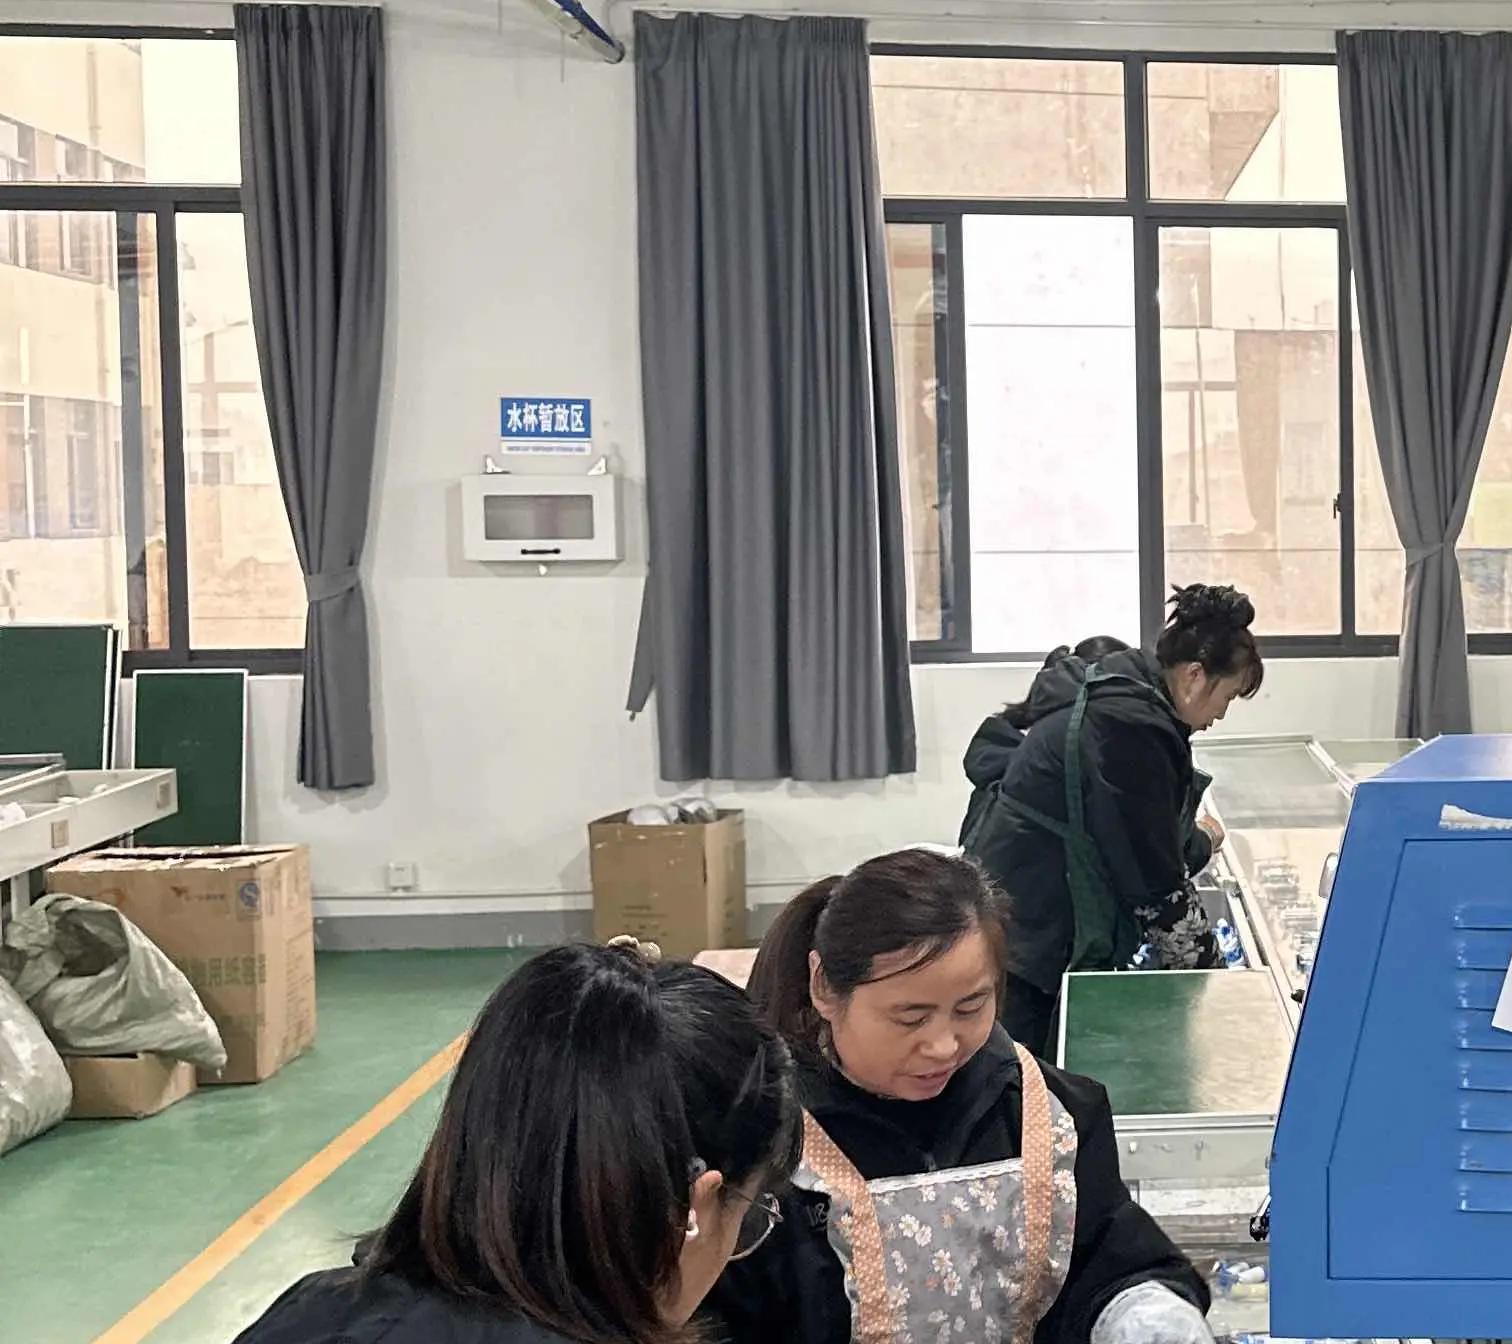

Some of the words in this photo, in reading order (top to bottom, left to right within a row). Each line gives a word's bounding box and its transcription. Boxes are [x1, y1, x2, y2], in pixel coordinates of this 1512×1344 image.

[507, 402, 585, 433] 水杯暂放区
